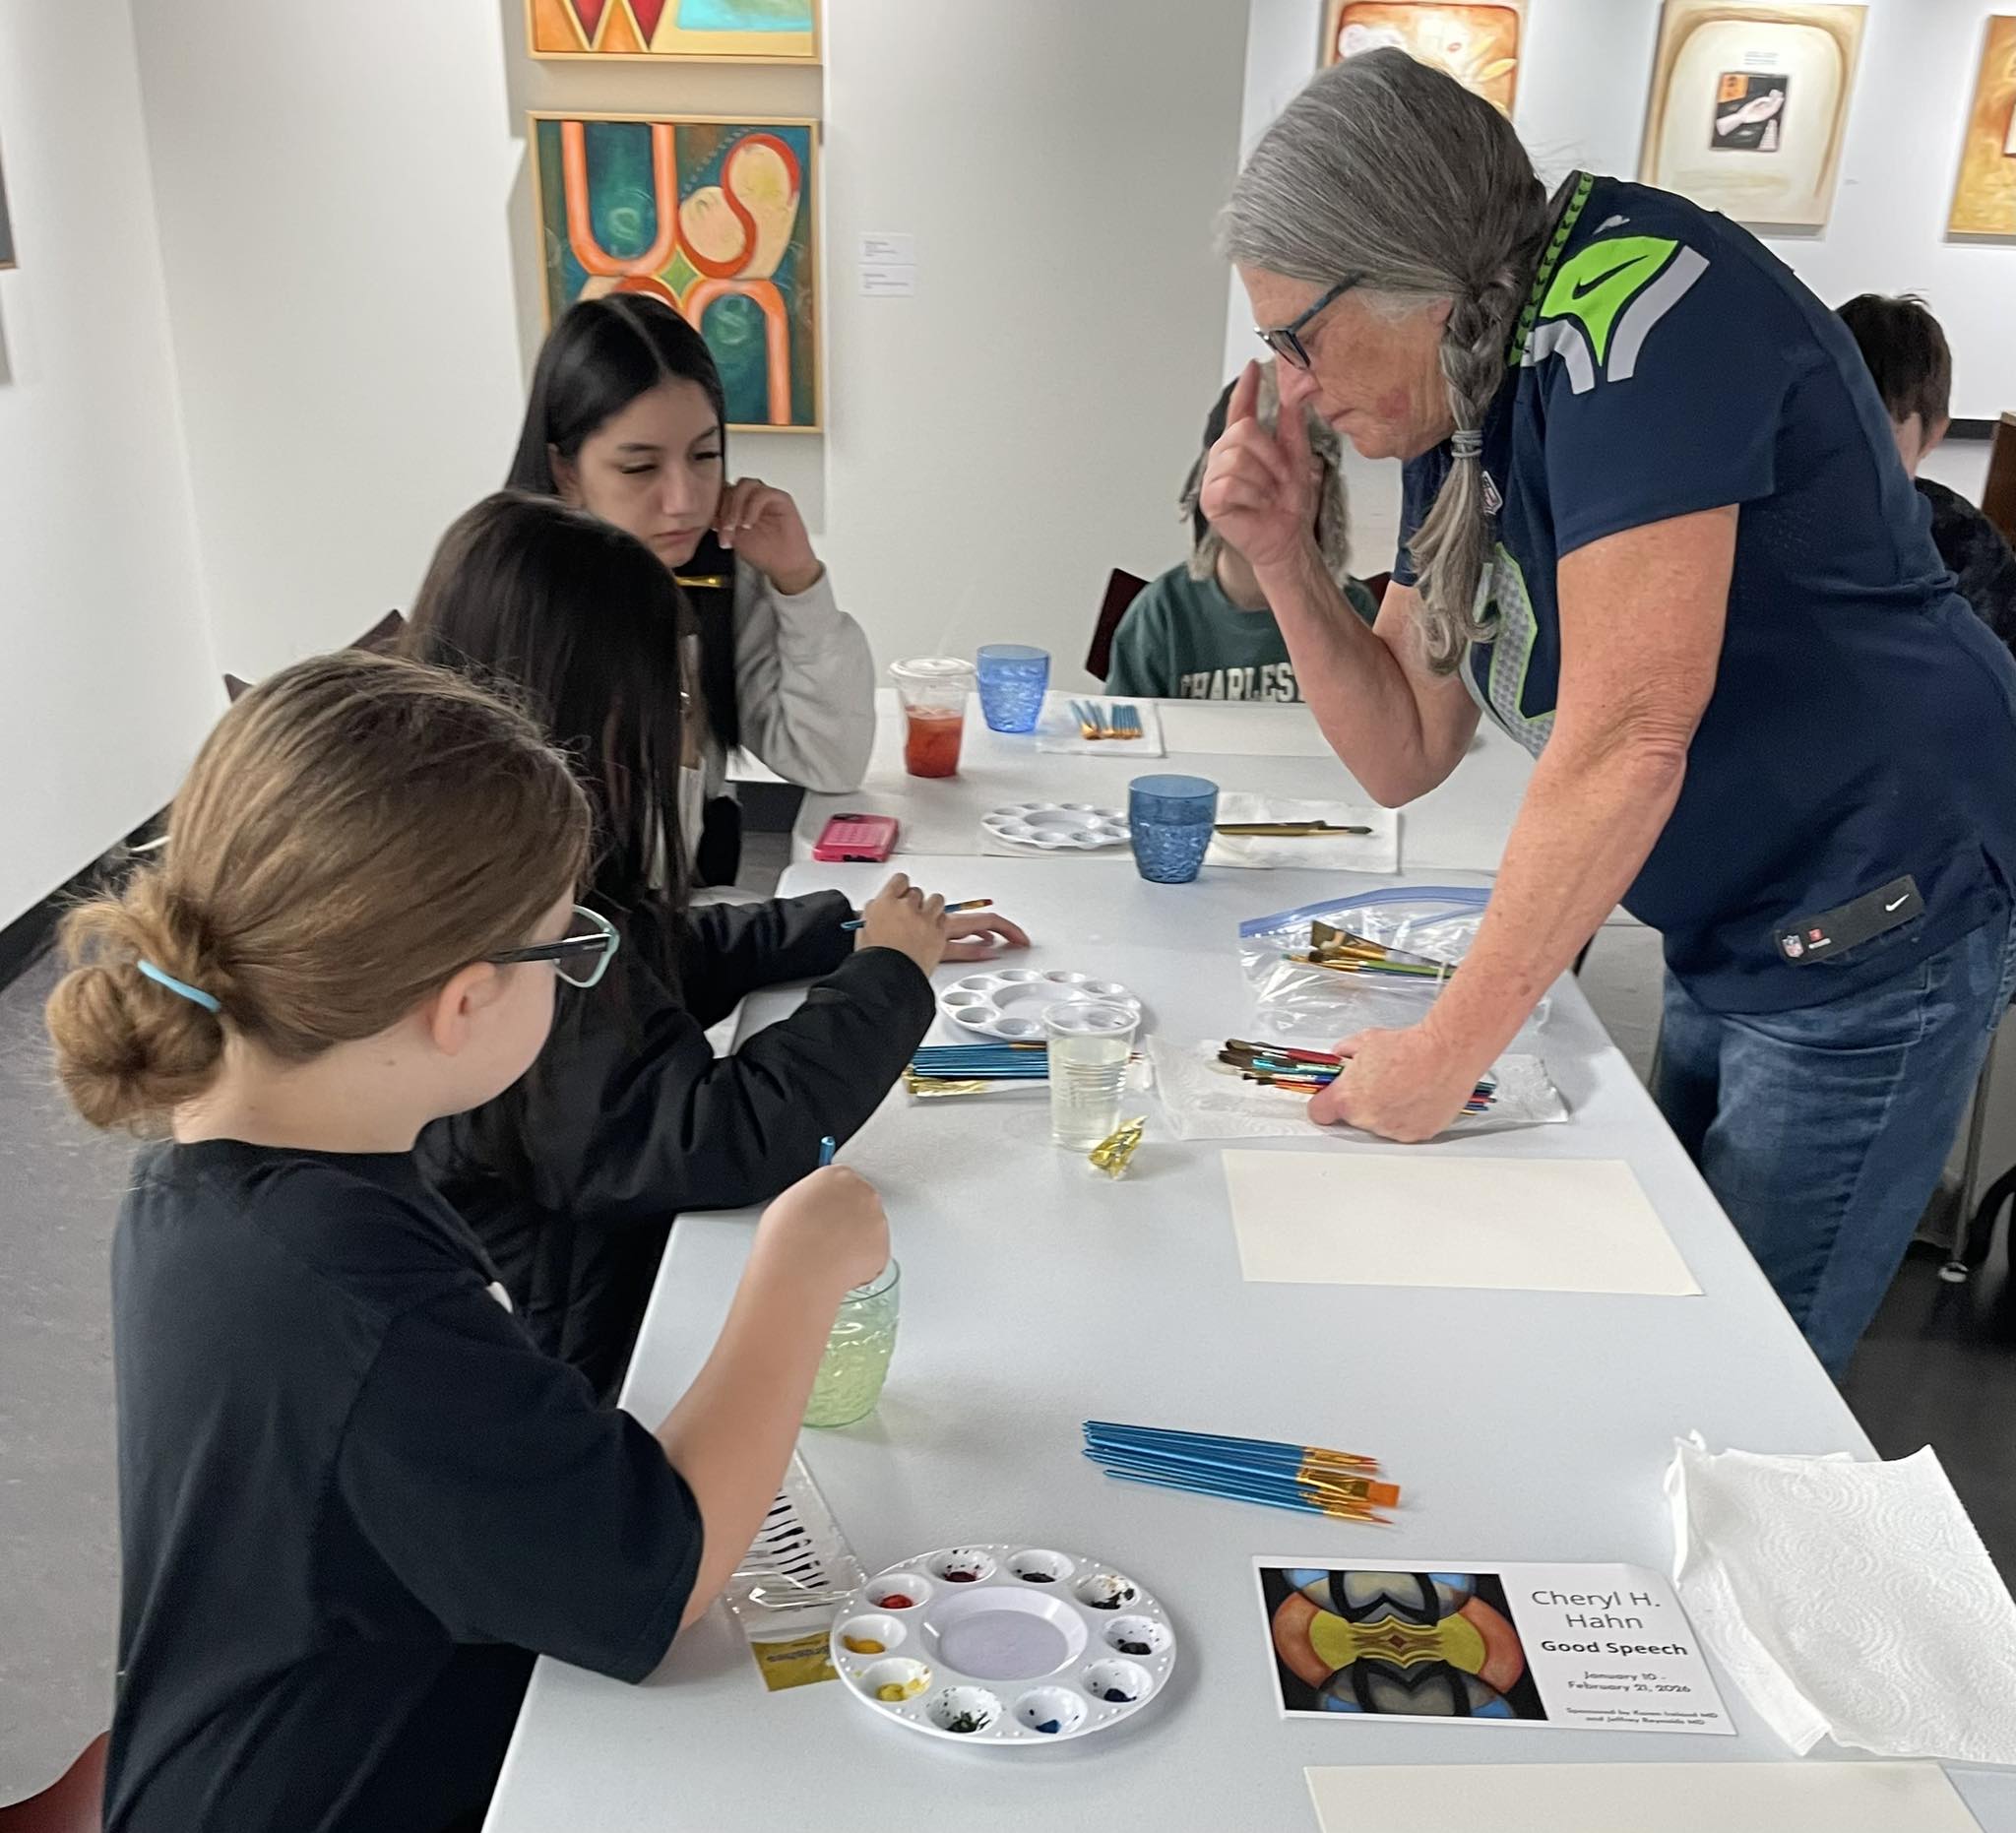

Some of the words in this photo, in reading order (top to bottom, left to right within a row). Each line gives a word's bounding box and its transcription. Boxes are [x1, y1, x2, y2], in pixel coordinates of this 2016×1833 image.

[1180, 662, 1305, 703] CHARLES
[1532, 1591, 1621, 1610] Cheryl
[1629, 1592, 1661, 1607] H.
[1566, 1613, 1643, 1628] Hahn
[1542, 1640, 1600, 1653] Good
[1606, 1642, 1688, 1656] Speech
[1585, 1672, 1637, 1681] January
[1568, 1680, 1630, 1691] February
